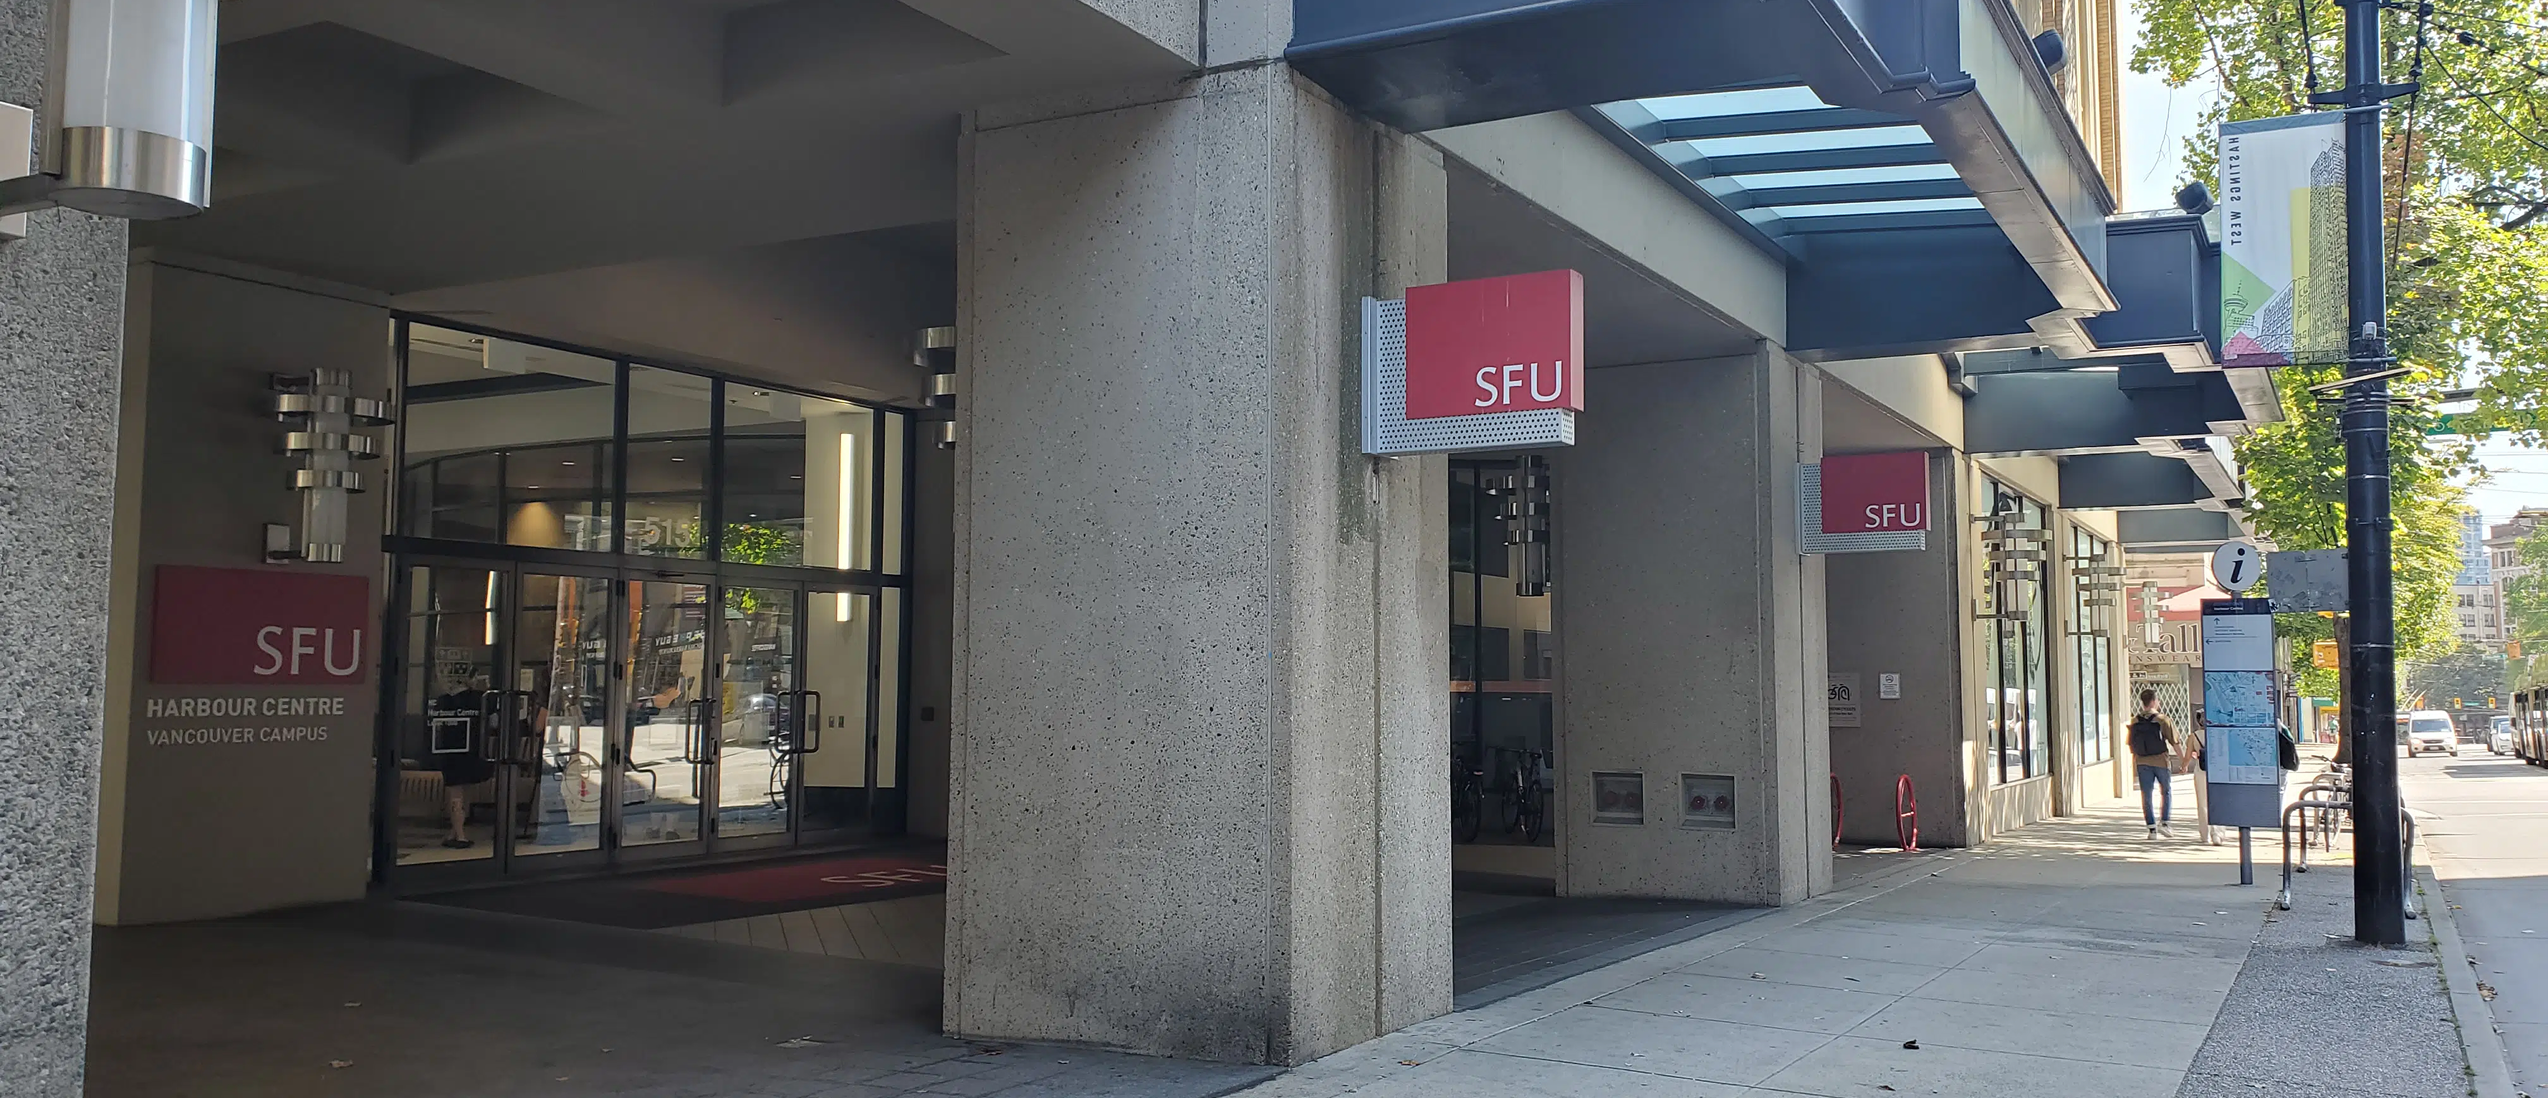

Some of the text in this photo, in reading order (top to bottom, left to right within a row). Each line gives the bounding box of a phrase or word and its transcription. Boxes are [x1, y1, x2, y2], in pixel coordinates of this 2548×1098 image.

[1474, 360, 1562, 407] SFU
[1865, 503, 1920, 528] SFU
[644, 516, 691, 547] 515
[253, 625, 361, 676] SFU
[146, 697, 344, 718] HARBOUR CENTRE
[146, 726, 328, 745] VANCOUVER CAMPUS
